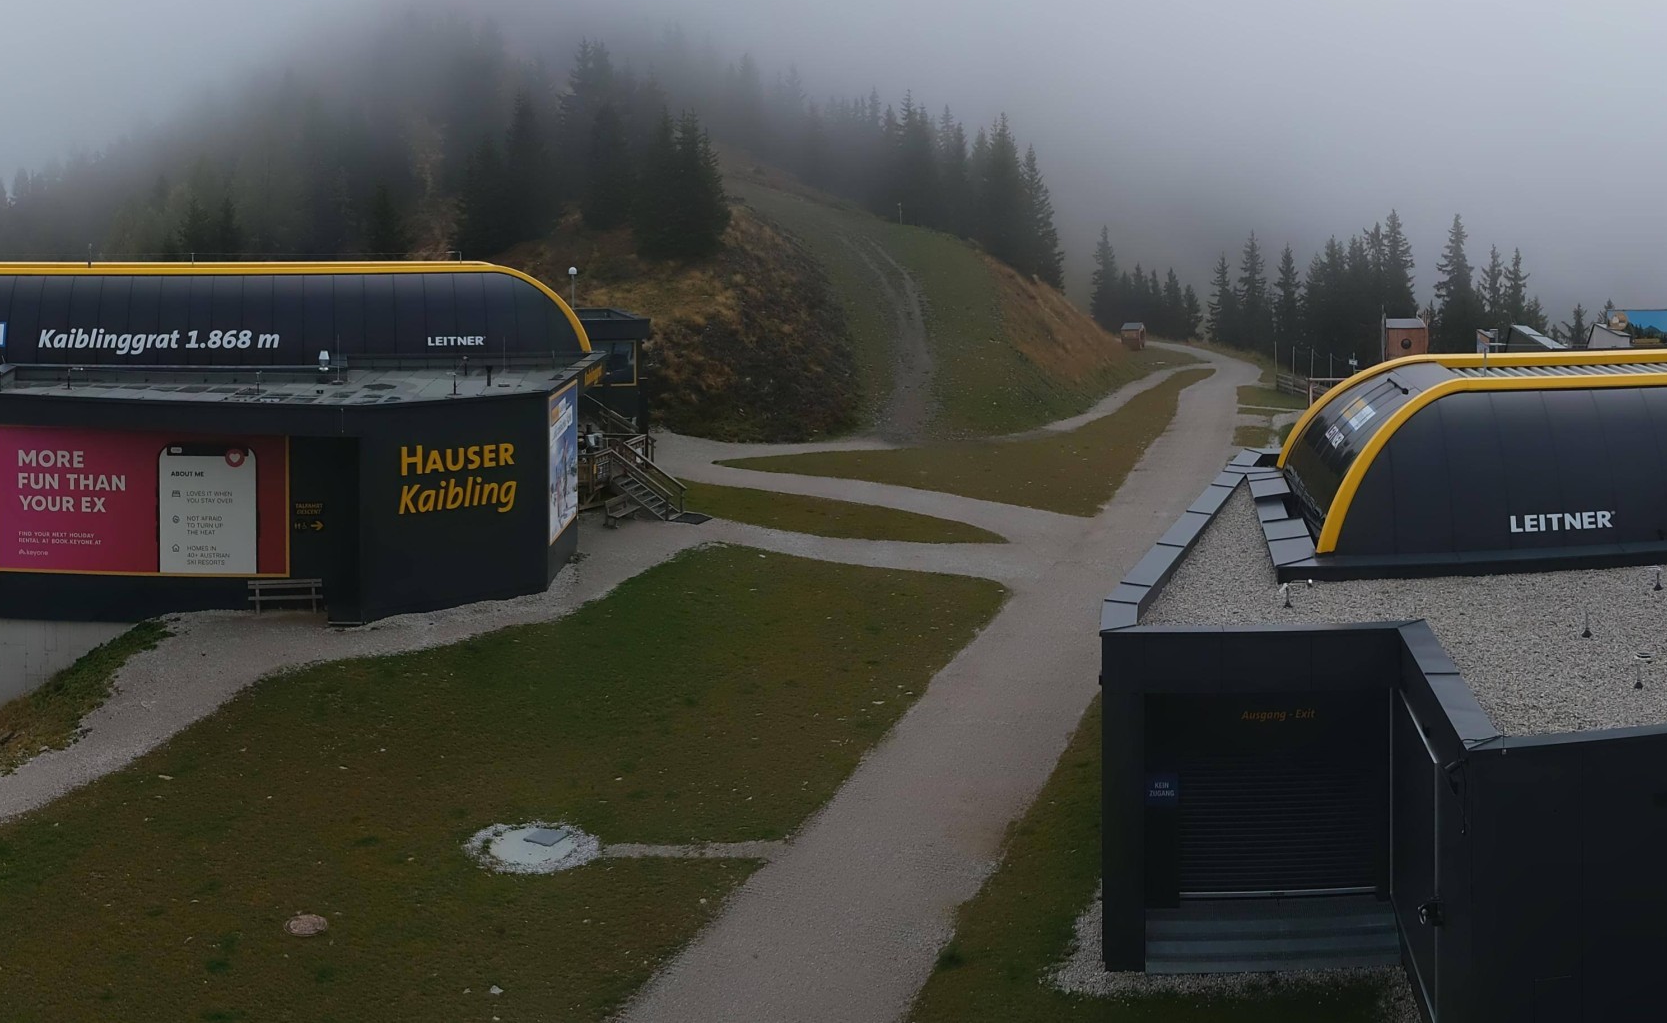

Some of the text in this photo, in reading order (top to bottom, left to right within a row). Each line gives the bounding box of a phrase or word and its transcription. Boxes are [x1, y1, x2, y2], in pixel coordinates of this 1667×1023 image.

[38, 328, 280, 355] Kaiblinggrat 1.868 m
[427, 336, 485, 346] LEITNER
[18, 449, 84, 468] MORE
[401, 443, 515, 476] HAUSER
[18, 473, 126, 491] FUN THAN
[19, 495, 106, 513] YOUR EX
[398, 476, 517, 515] Kaibling
[1510, 511, 1613, 533] LEITNER
[1241, 710, 1287, 721] Ausgang
[1295, 709, 1315, 719] Exit
